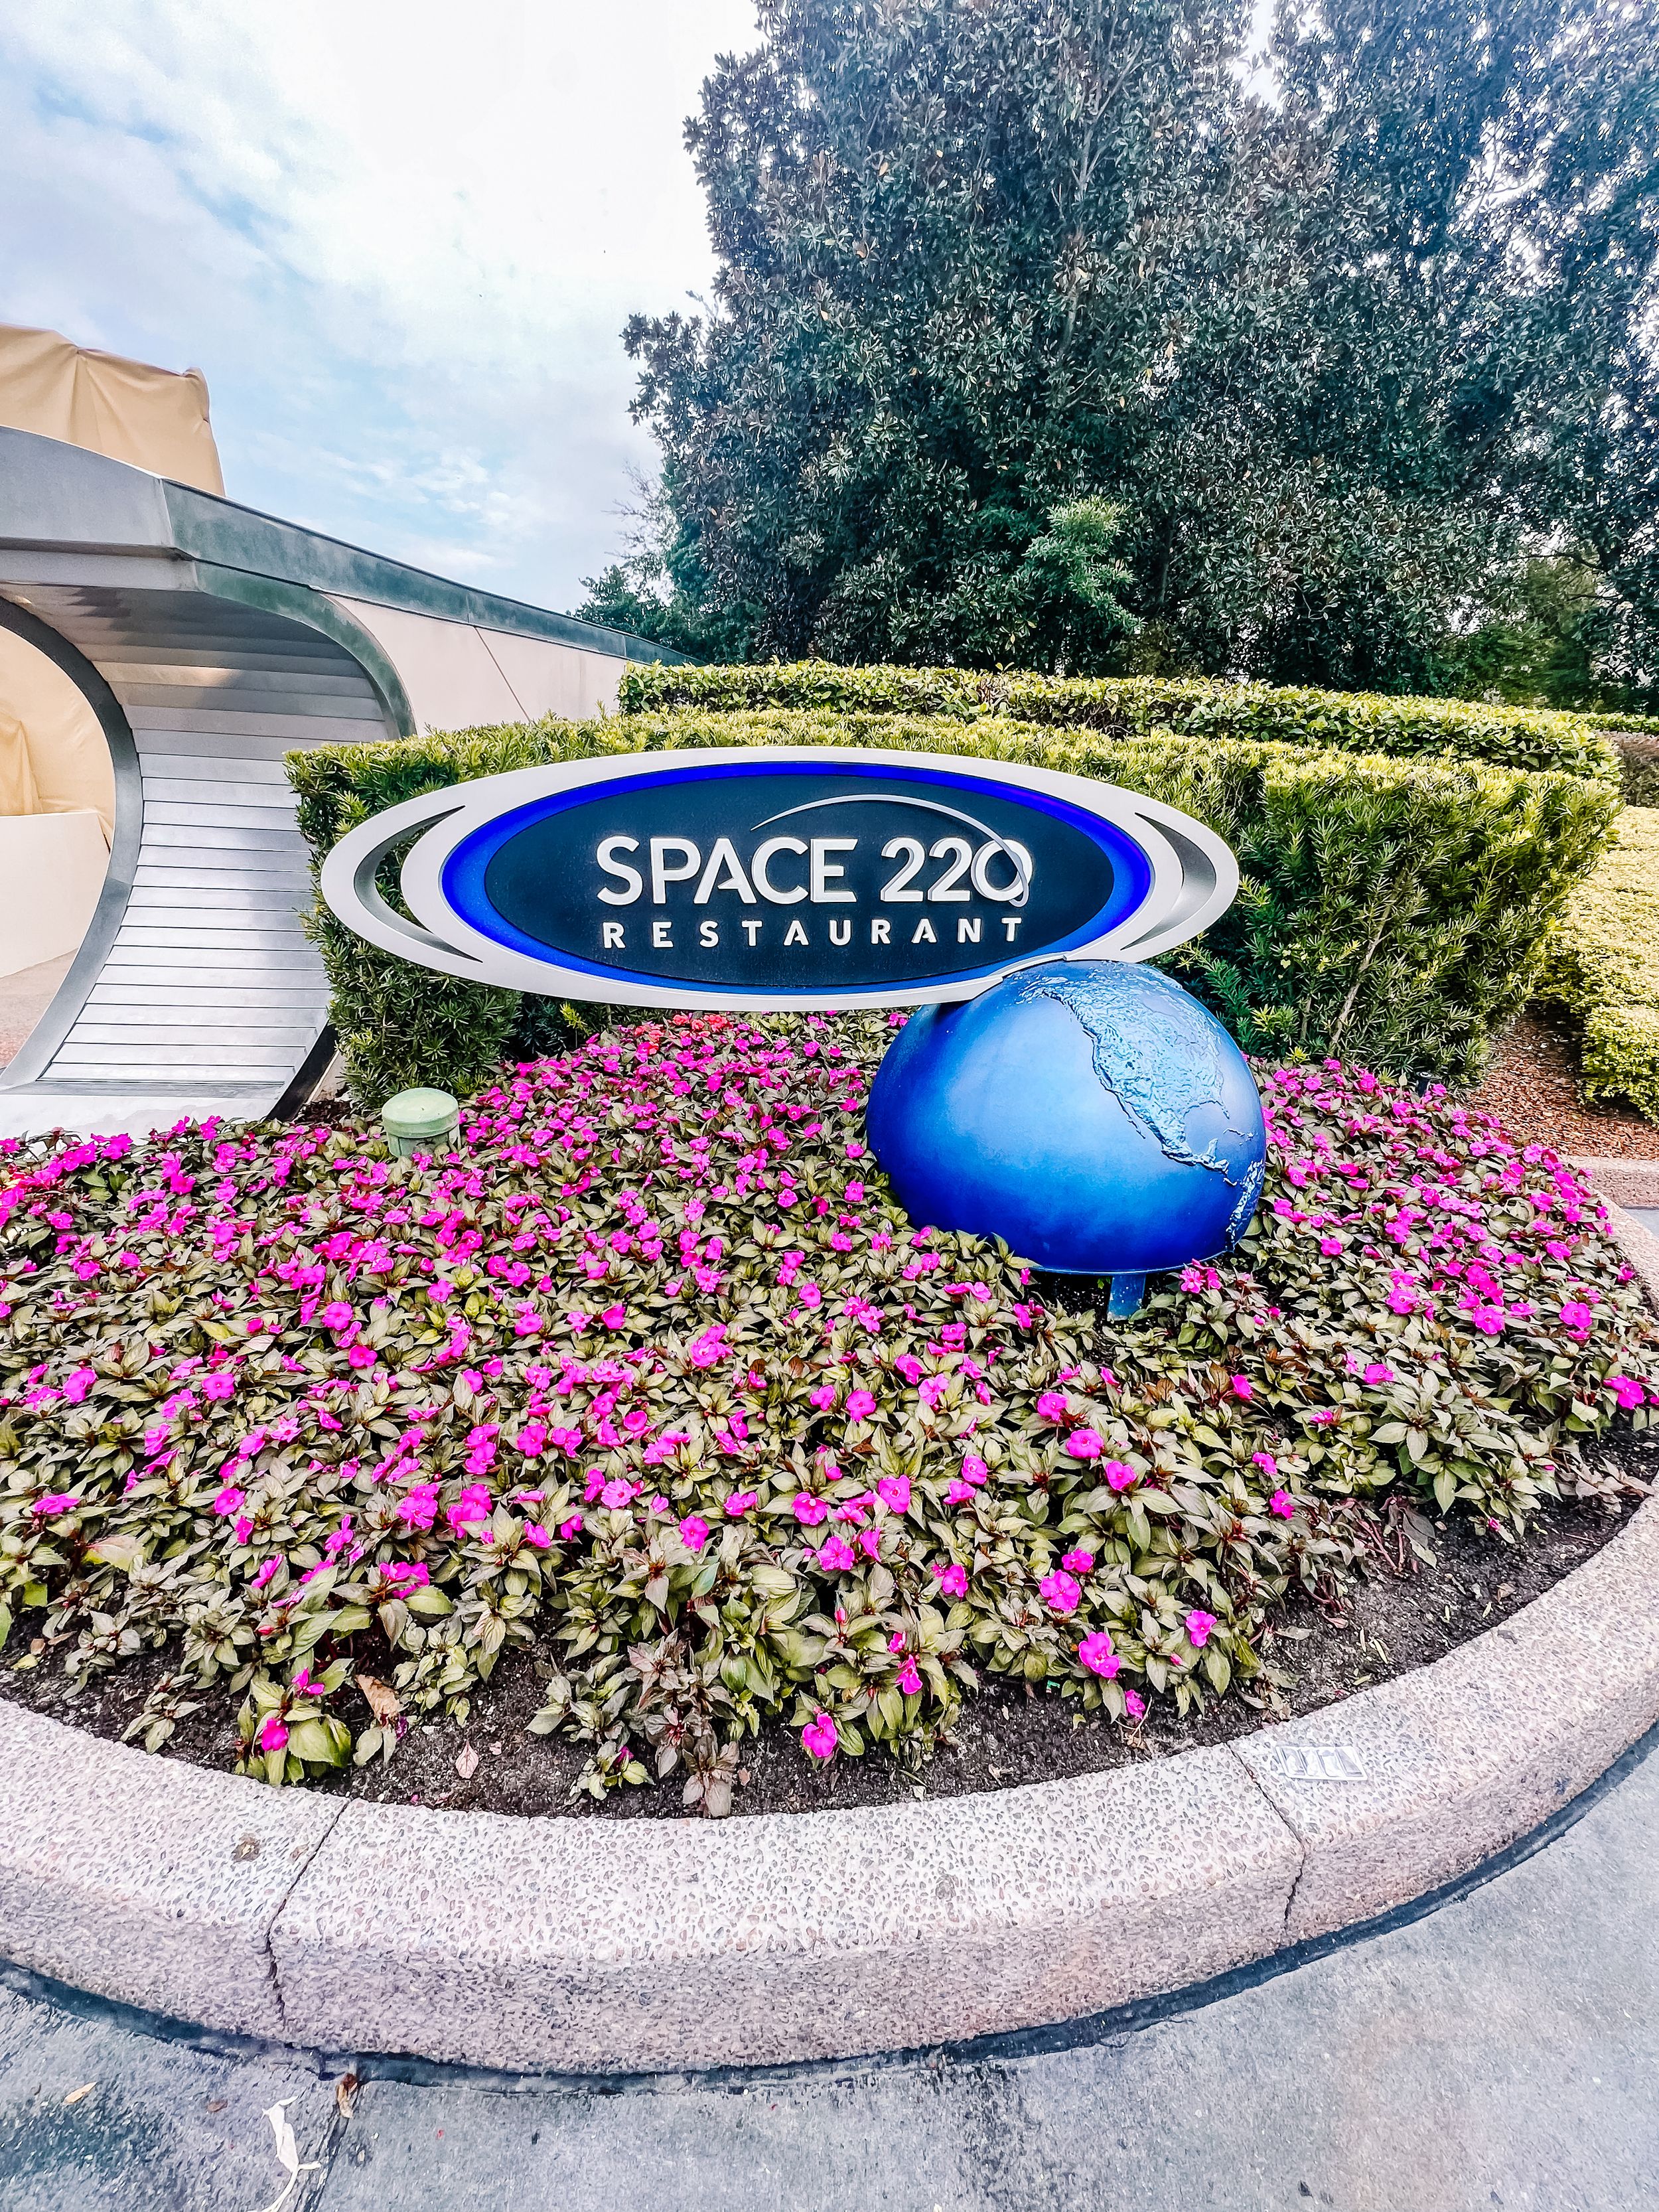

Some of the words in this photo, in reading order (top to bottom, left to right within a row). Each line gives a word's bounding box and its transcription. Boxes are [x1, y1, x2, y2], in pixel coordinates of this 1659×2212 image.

[597, 836, 858, 906] SPACE
[880, 837, 1033, 907] 220
[603, 917, 1022, 948] RESTAURANT
